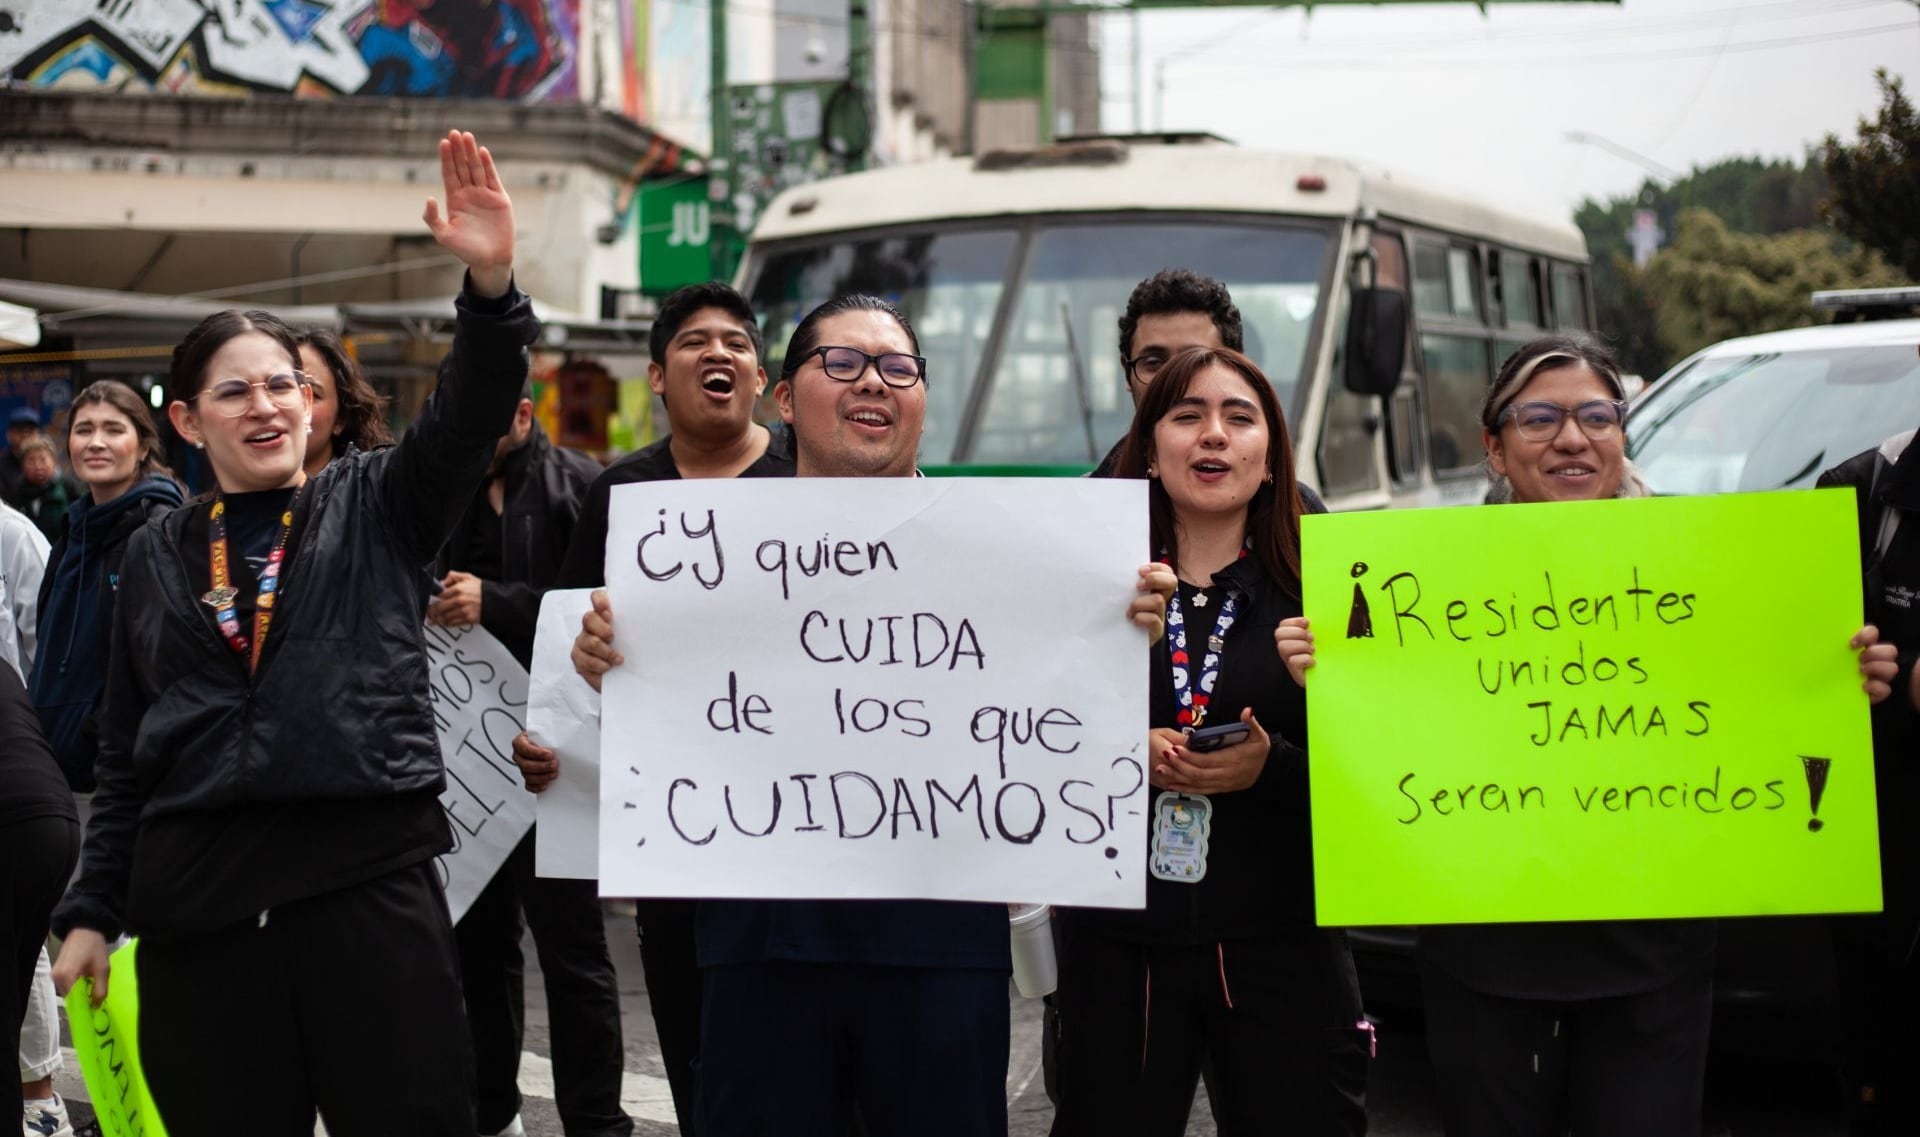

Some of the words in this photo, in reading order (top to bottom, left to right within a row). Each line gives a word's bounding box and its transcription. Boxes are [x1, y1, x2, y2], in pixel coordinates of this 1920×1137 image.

[755, 535, 899, 600] quien
[1345, 561, 1697, 647] ¡Residentes
[799, 609, 986, 672] CUIDA
[706, 670, 775, 736] de
[834, 687, 932, 738] los
[969, 705, 1083, 780] que
[1526, 700, 1711, 747] JAMAS
[1397, 772, 1545, 825] Seran
